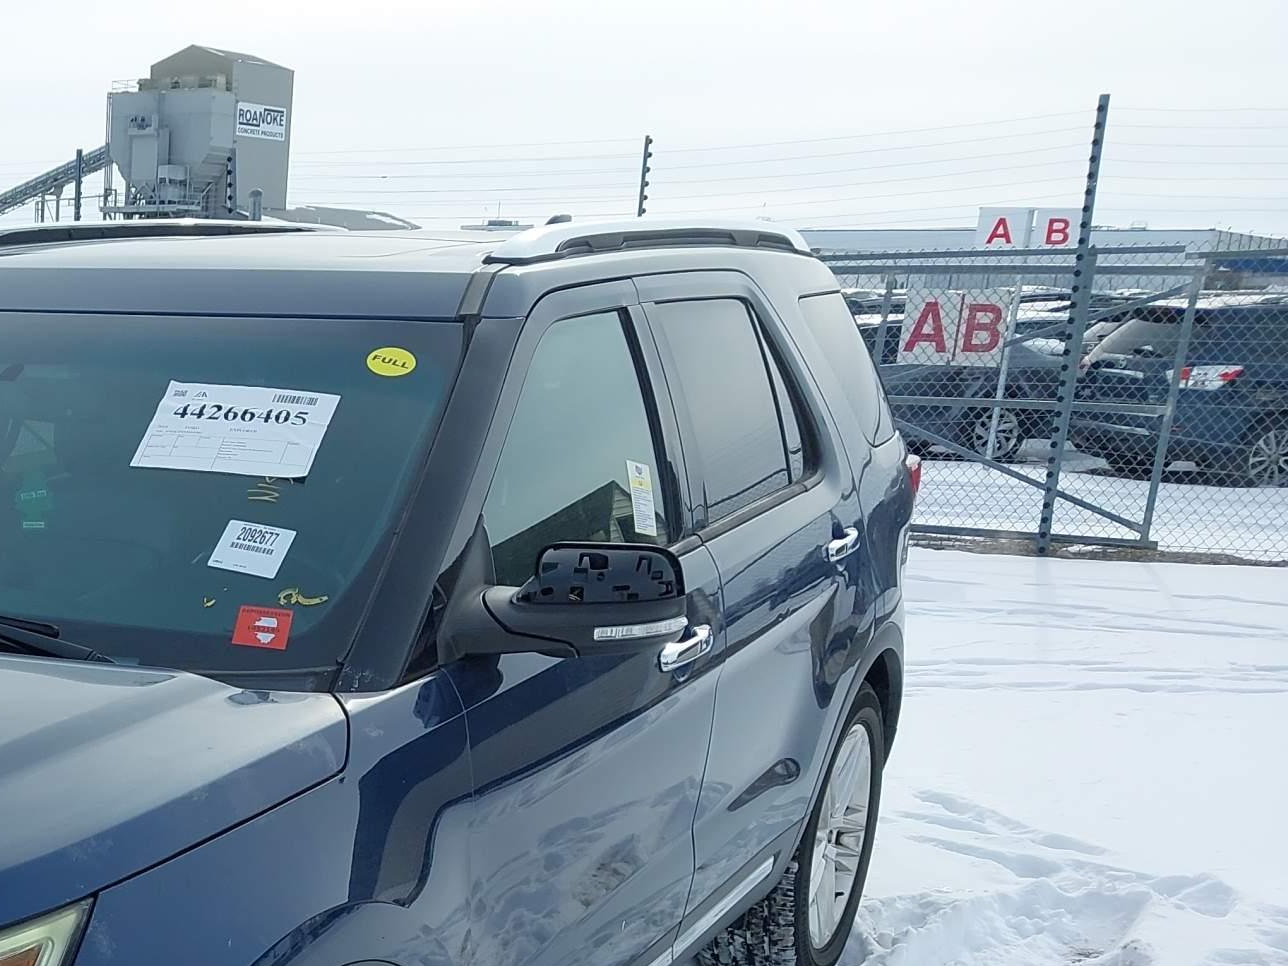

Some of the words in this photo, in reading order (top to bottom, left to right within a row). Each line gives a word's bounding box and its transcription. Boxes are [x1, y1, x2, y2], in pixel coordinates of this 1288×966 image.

[239, 108, 284, 127] ROANOKE
[985, 217, 1012, 245] A
[1045, 218, 1070, 245] B
[903, 301, 947, 353] A
[961, 303, 1003, 353] B
[372, 354, 409, 370] FULL
[173, 403, 309, 426] 44266405
[236, 526, 280, 548] 2092677
